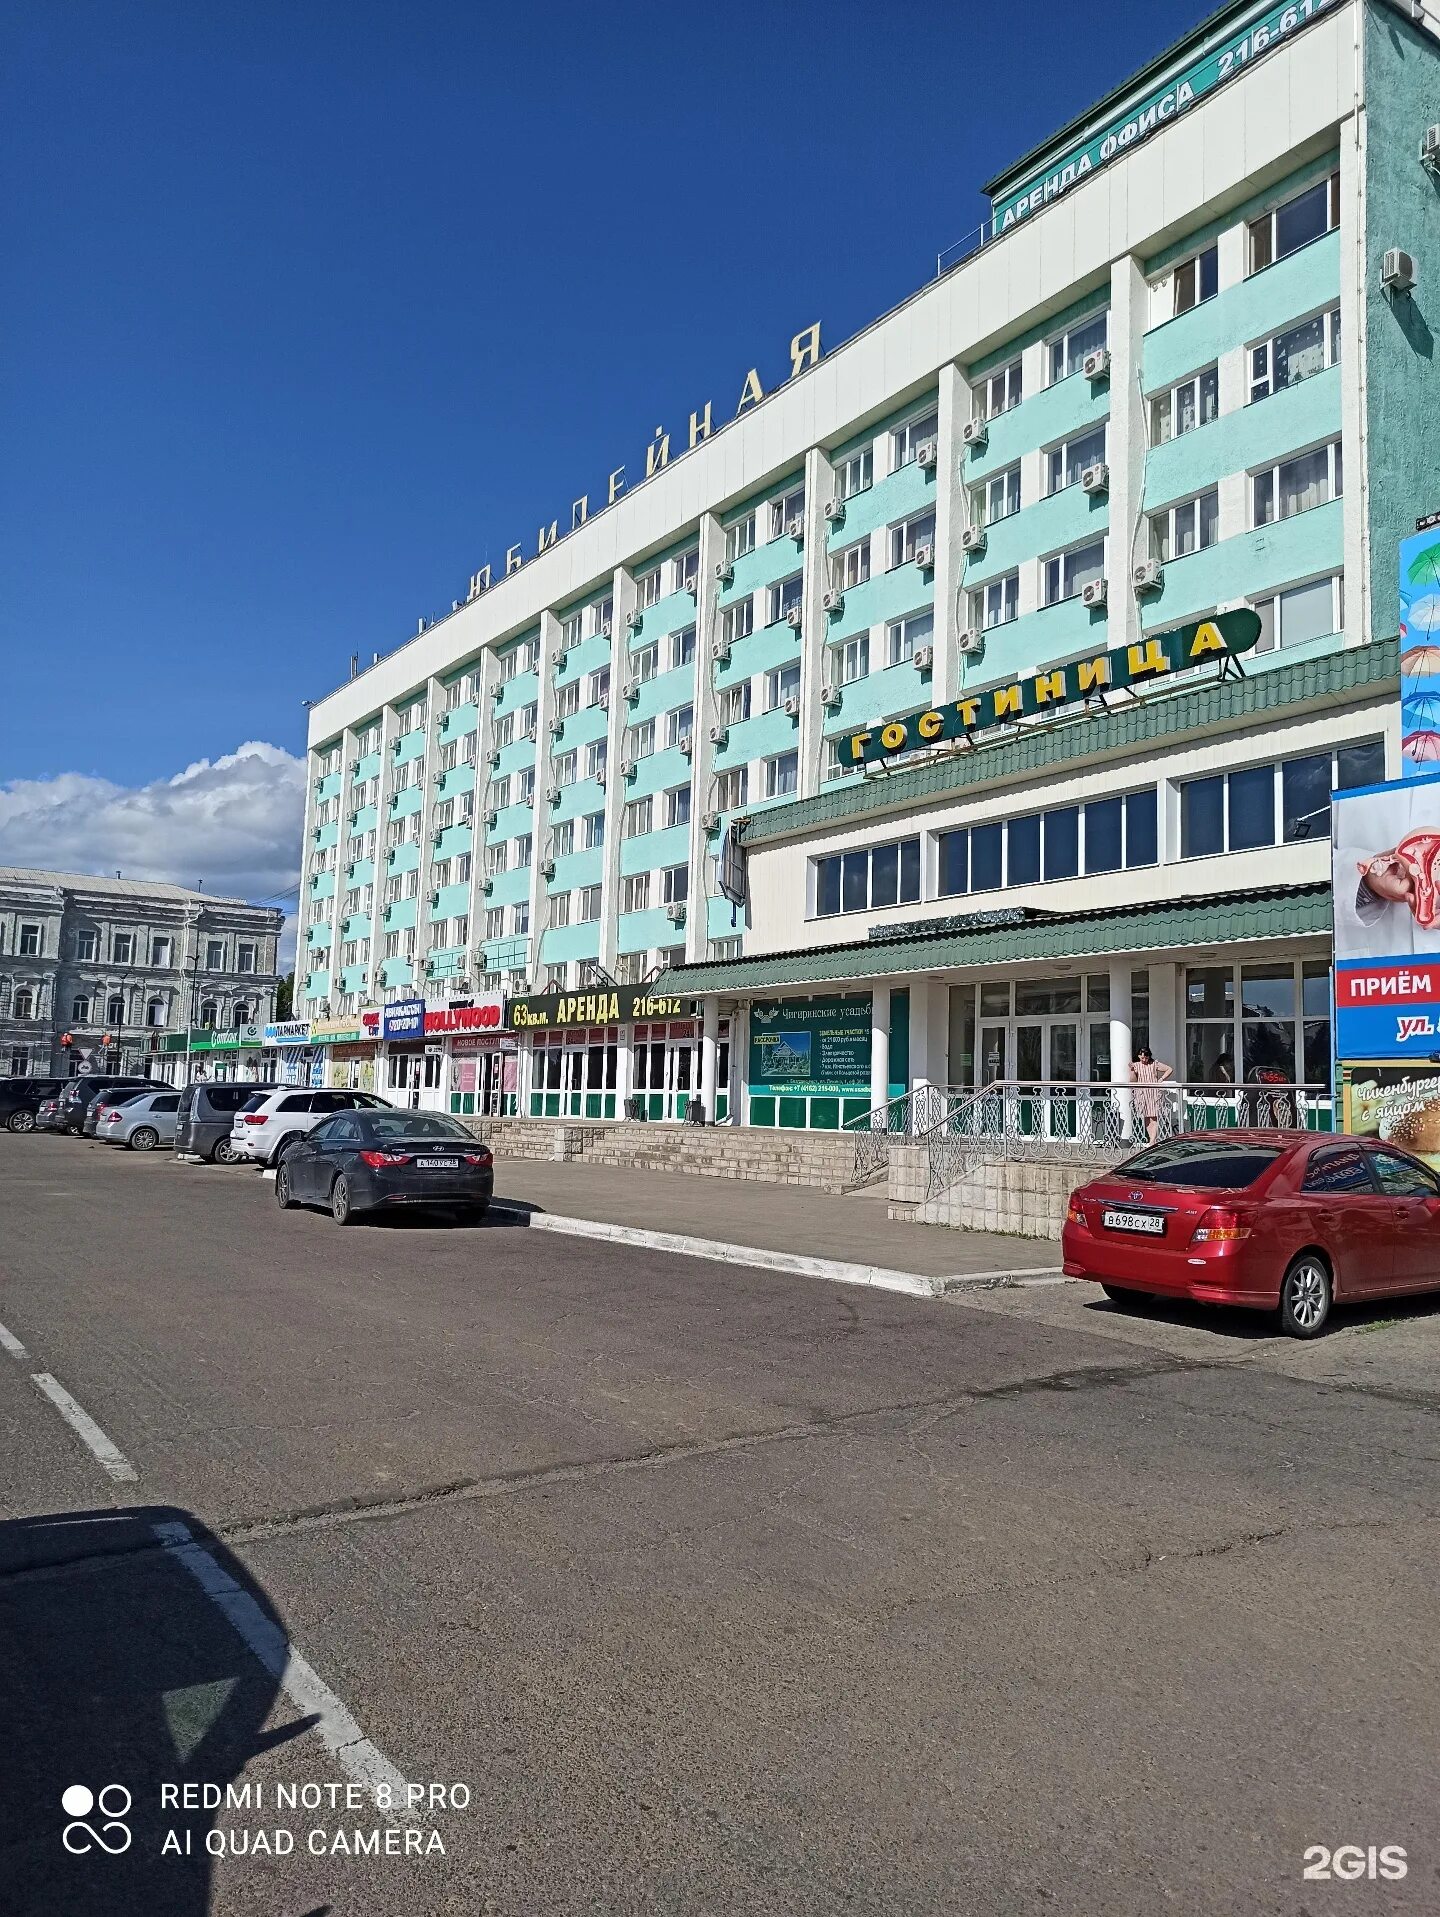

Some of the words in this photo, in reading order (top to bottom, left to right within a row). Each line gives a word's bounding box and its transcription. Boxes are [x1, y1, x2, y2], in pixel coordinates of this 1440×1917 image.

[1000, 153, 1093, 231] АРЕНДА
[1099, 80, 1195, 161] ОФИСА
[1217, 0, 1338, 80] 216-61
[850, 621, 1228, 760] ГОСТИНИЦА
[1350, 970, 1432, 997] ПРИЁМ
[556, 992, 620, 1024] АРЕНДА
[632, 997, 681, 1017] 216-612
[782, 1007, 837, 1020] Чигиринские
[840, 1003, 872, 1020] усадьб
[1398, 1017, 1433, 1040] ул.
[1375, 1100, 1426, 1119] яйцом
